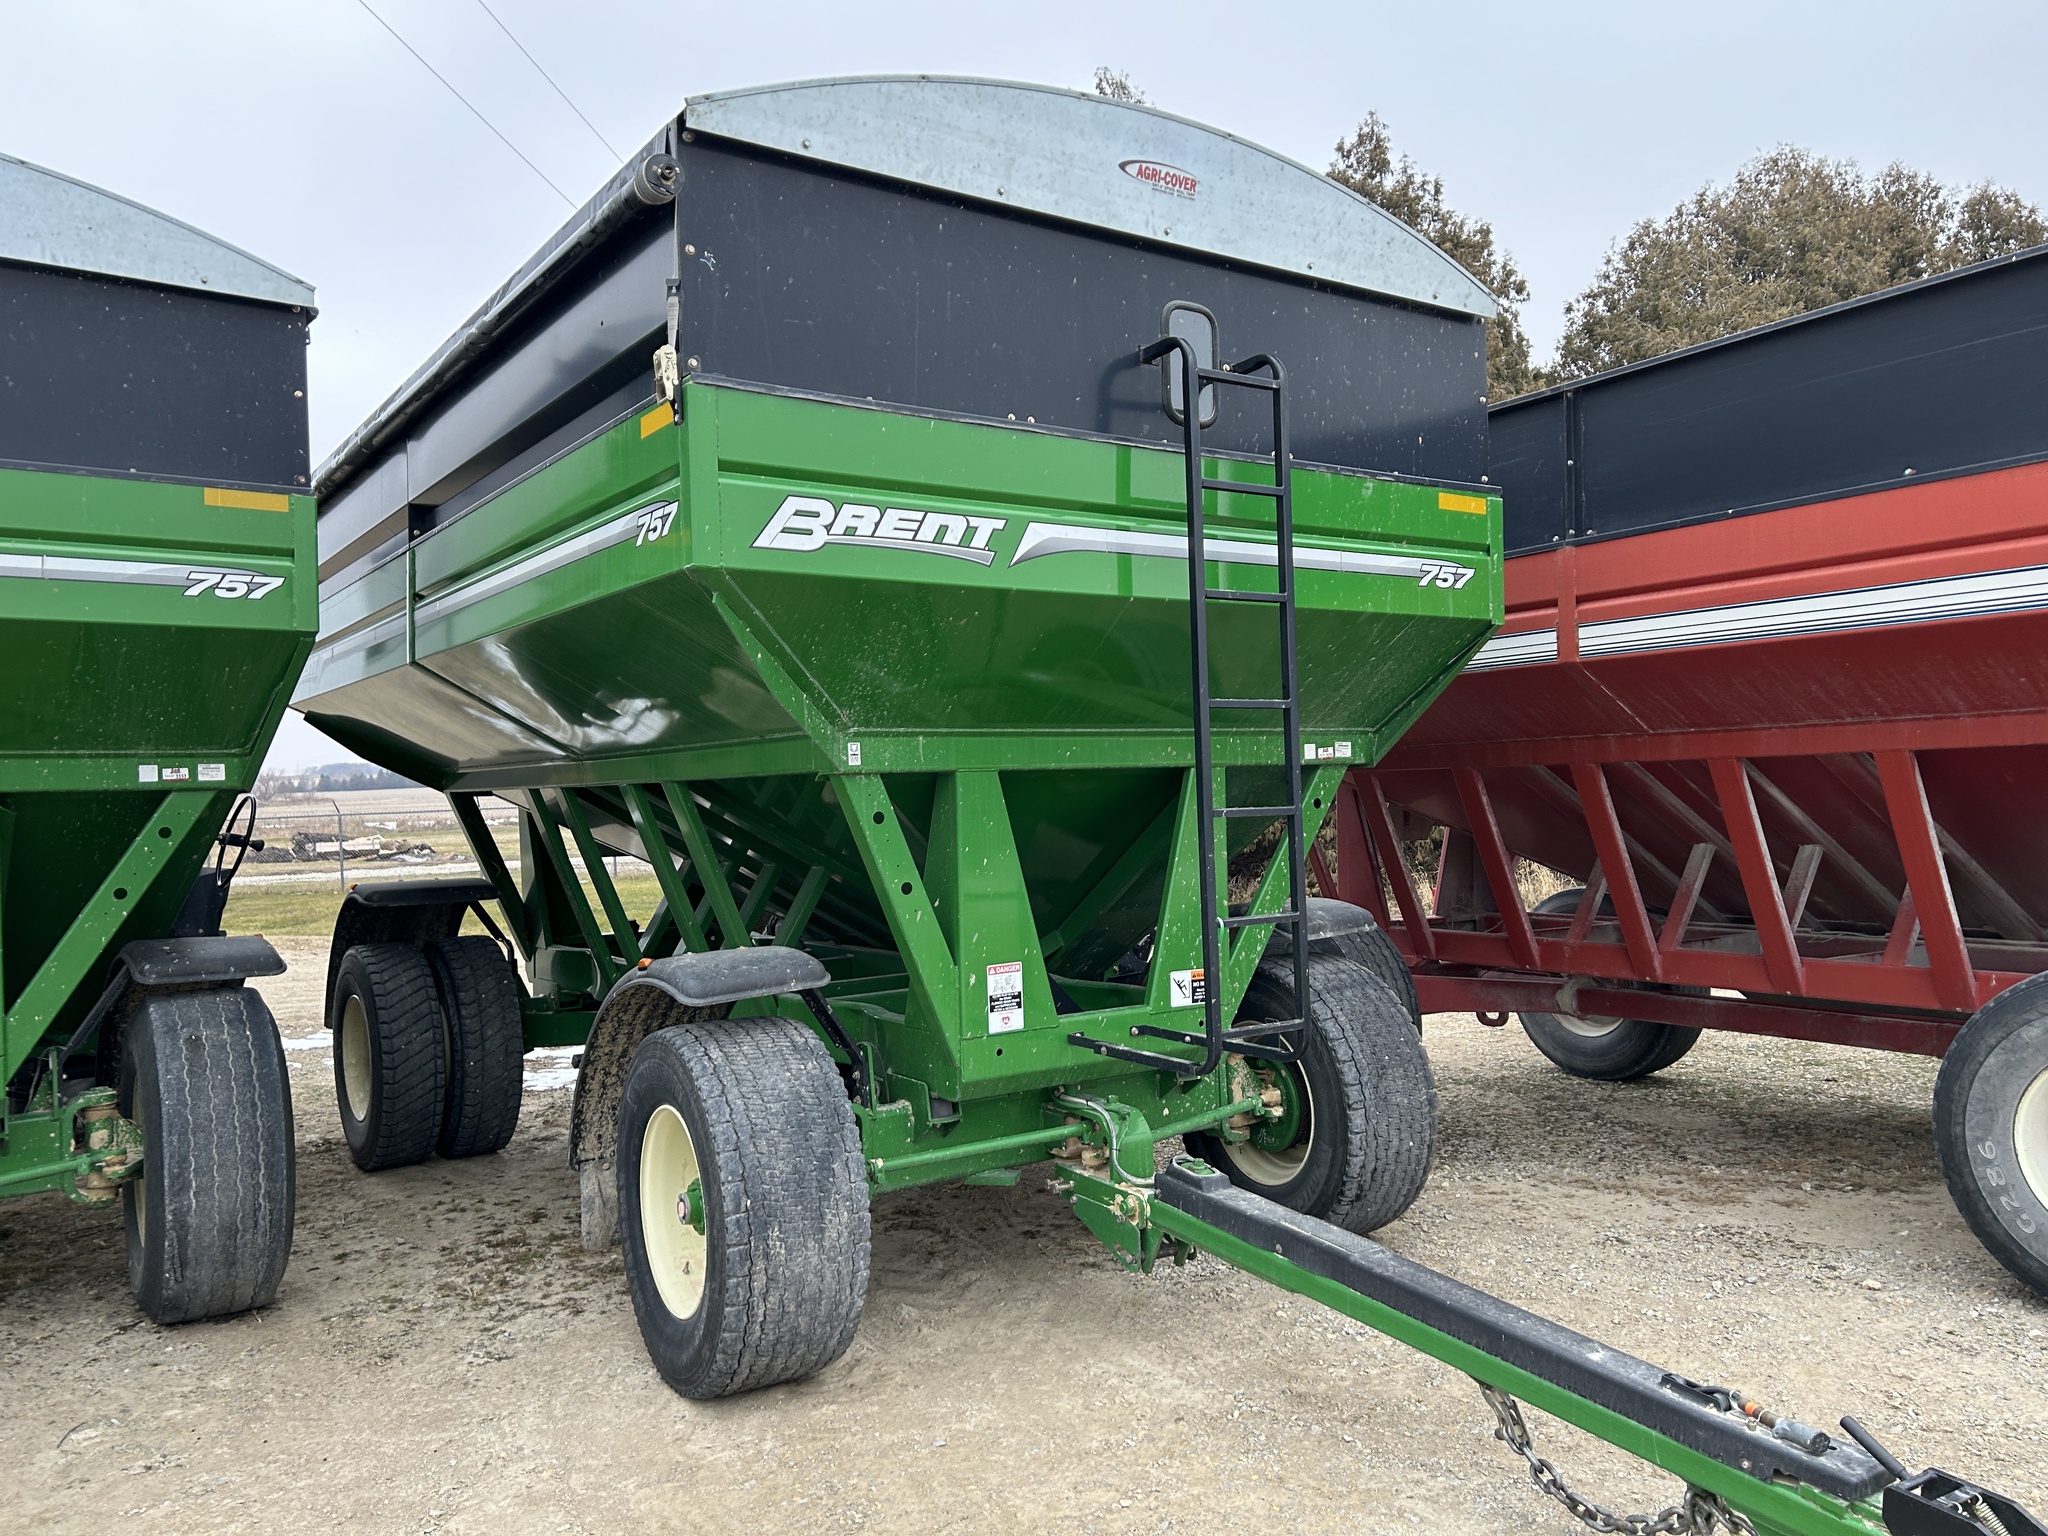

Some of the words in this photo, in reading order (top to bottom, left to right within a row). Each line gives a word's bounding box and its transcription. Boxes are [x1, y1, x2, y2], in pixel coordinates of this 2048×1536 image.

[1136, 164, 1197, 192] AGRI-COVER
[635, 500, 679, 548] 757
[750, 494, 1008, 553] BRENT
[182, 571, 286, 600] 757
[1418, 563, 1476, 589] 757
[996, 964, 1020, 974] DANGER
[1978, 1140, 2036, 1234] G286
